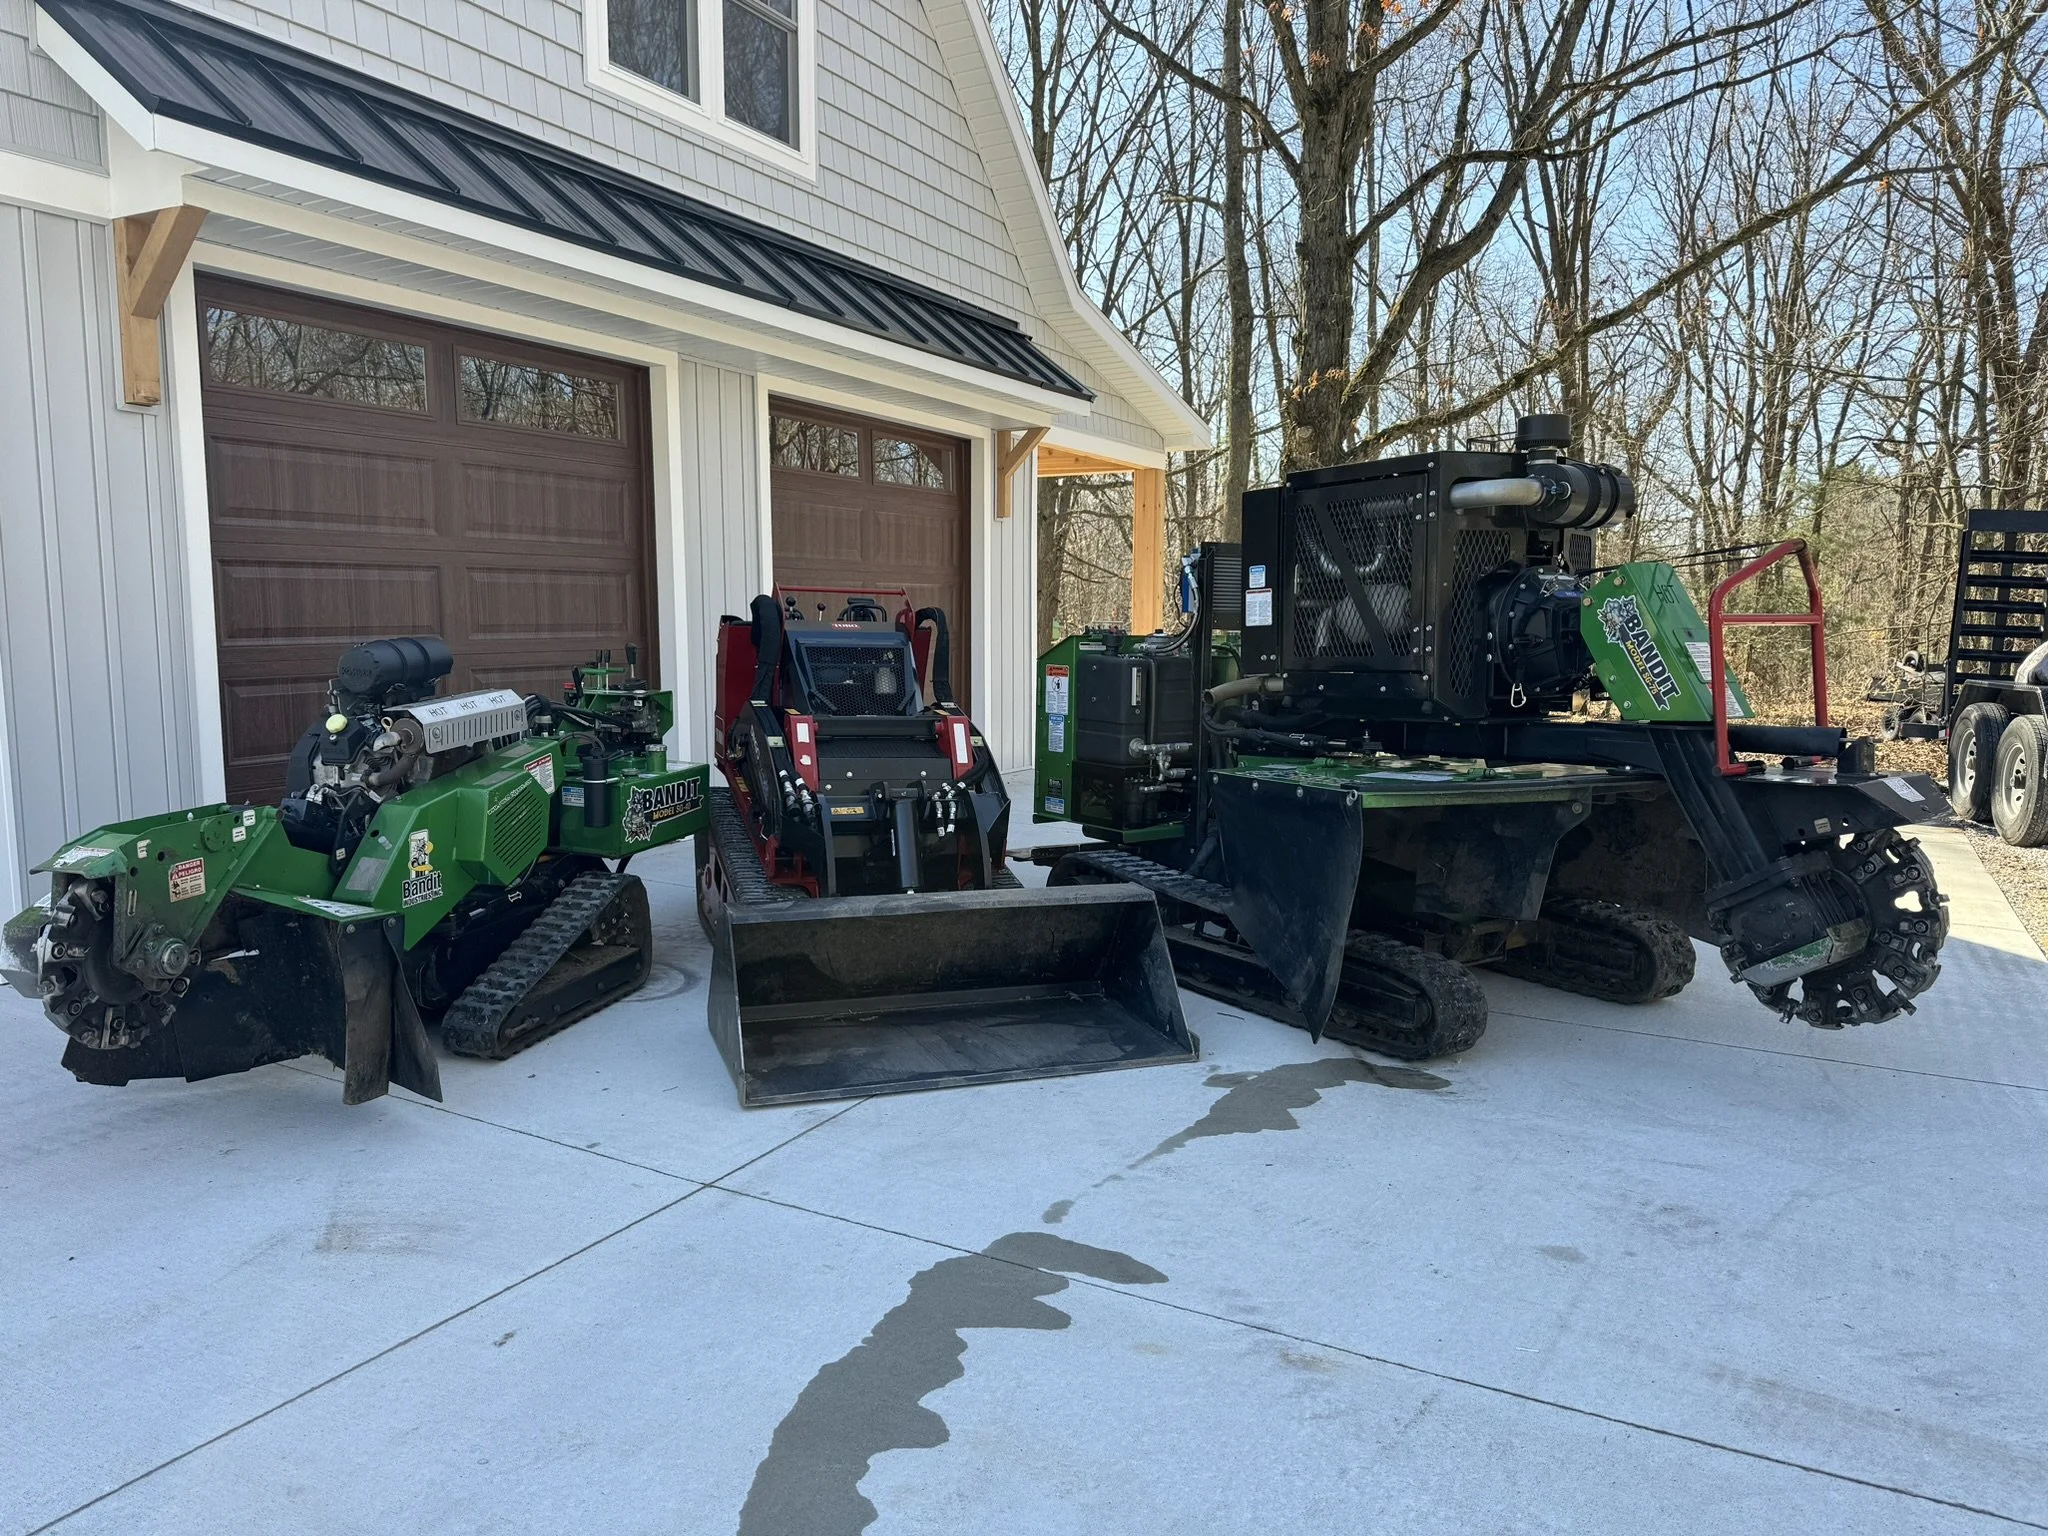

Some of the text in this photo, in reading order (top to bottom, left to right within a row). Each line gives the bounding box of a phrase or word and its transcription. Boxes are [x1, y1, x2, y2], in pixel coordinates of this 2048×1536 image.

[1653, 584, 1680, 604] HOT
[1625, 613, 1681, 698] BANDIT
[1625, 640, 1661, 696] MODEL SG-75
[428, 694, 506, 717] HOT HOT HOT
[642, 777, 700, 812] BANDIT
[652, 807, 675, 820] MODEL
[178, 860, 201, 871] DANGER
[178, 867, 202, 878] PELIGRO
[403, 872, 441, 899] Bandit
[403, 891, 432, 907] INDUSTRIES
